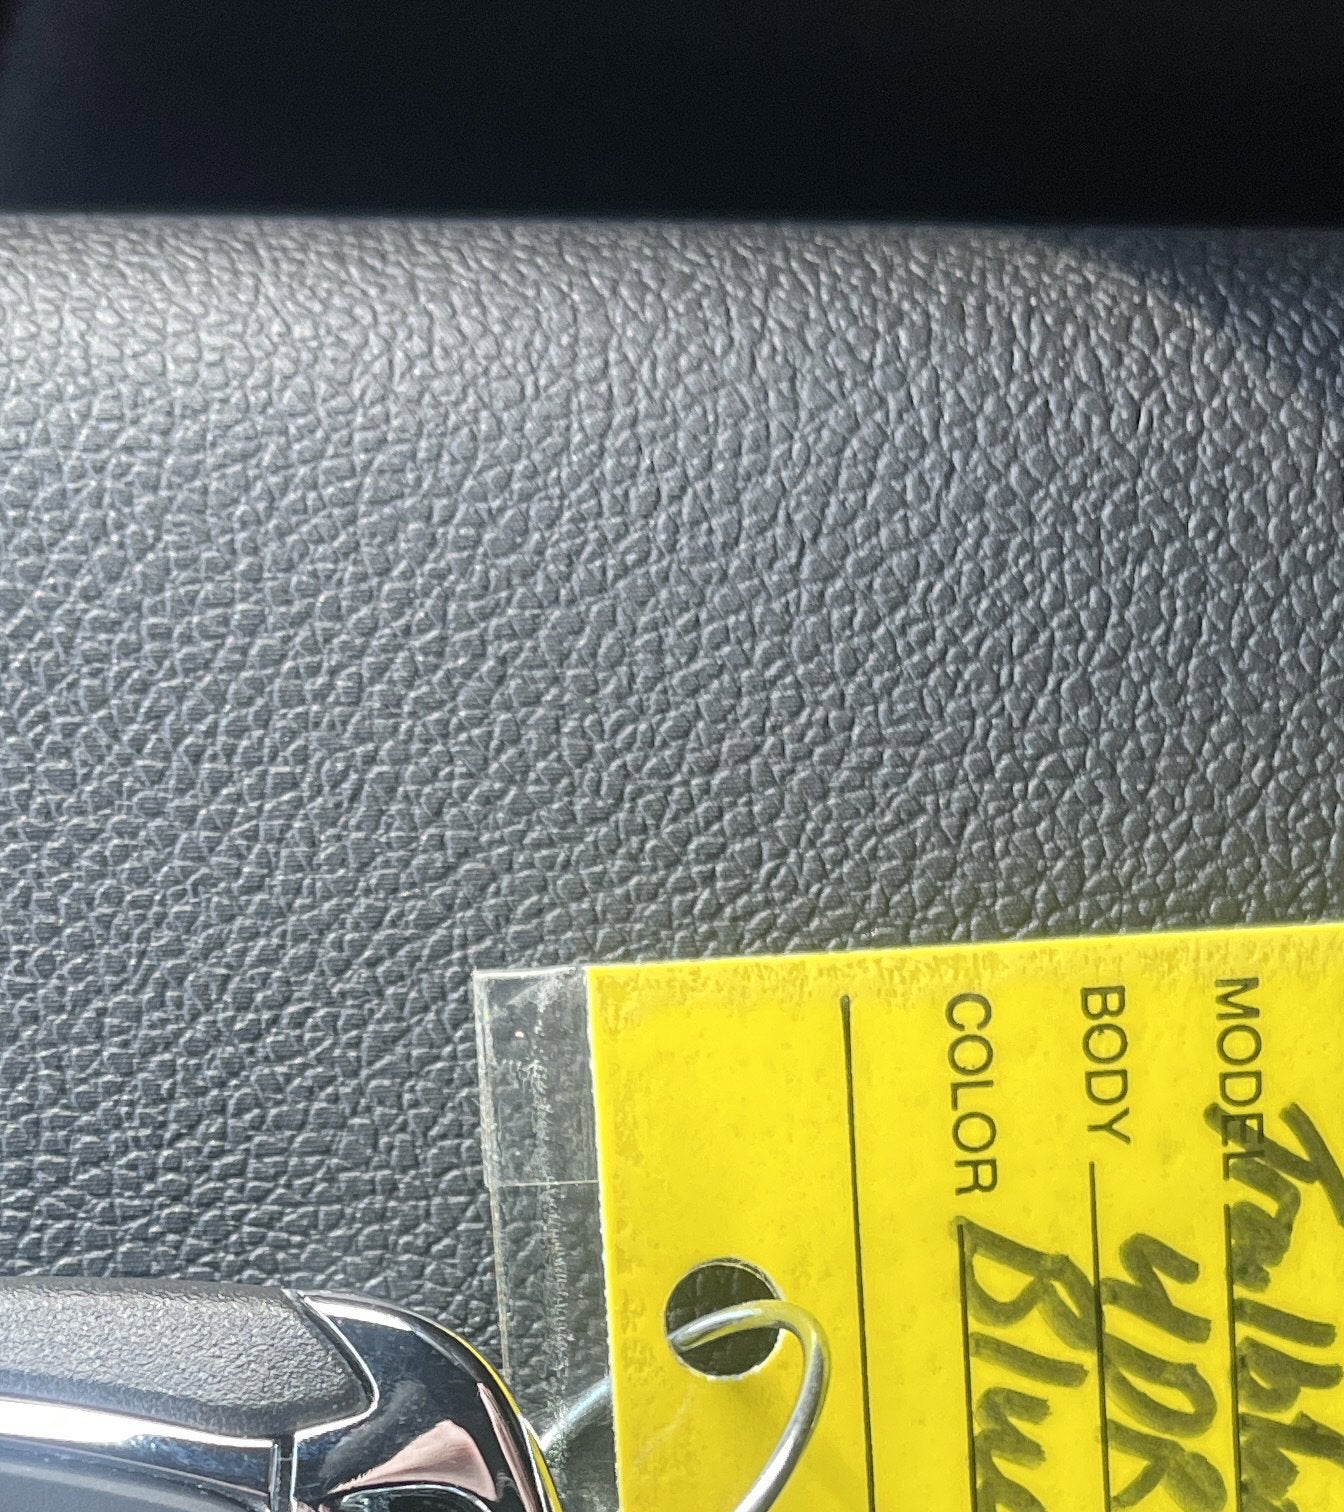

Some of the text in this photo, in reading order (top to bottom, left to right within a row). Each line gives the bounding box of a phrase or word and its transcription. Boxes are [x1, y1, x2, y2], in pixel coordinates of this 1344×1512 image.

[944, 992, 998, 1197] COLOR
[1079, 984, 1131, 1146] BODY
[1214, 976, 1266, 1181] MODEL
